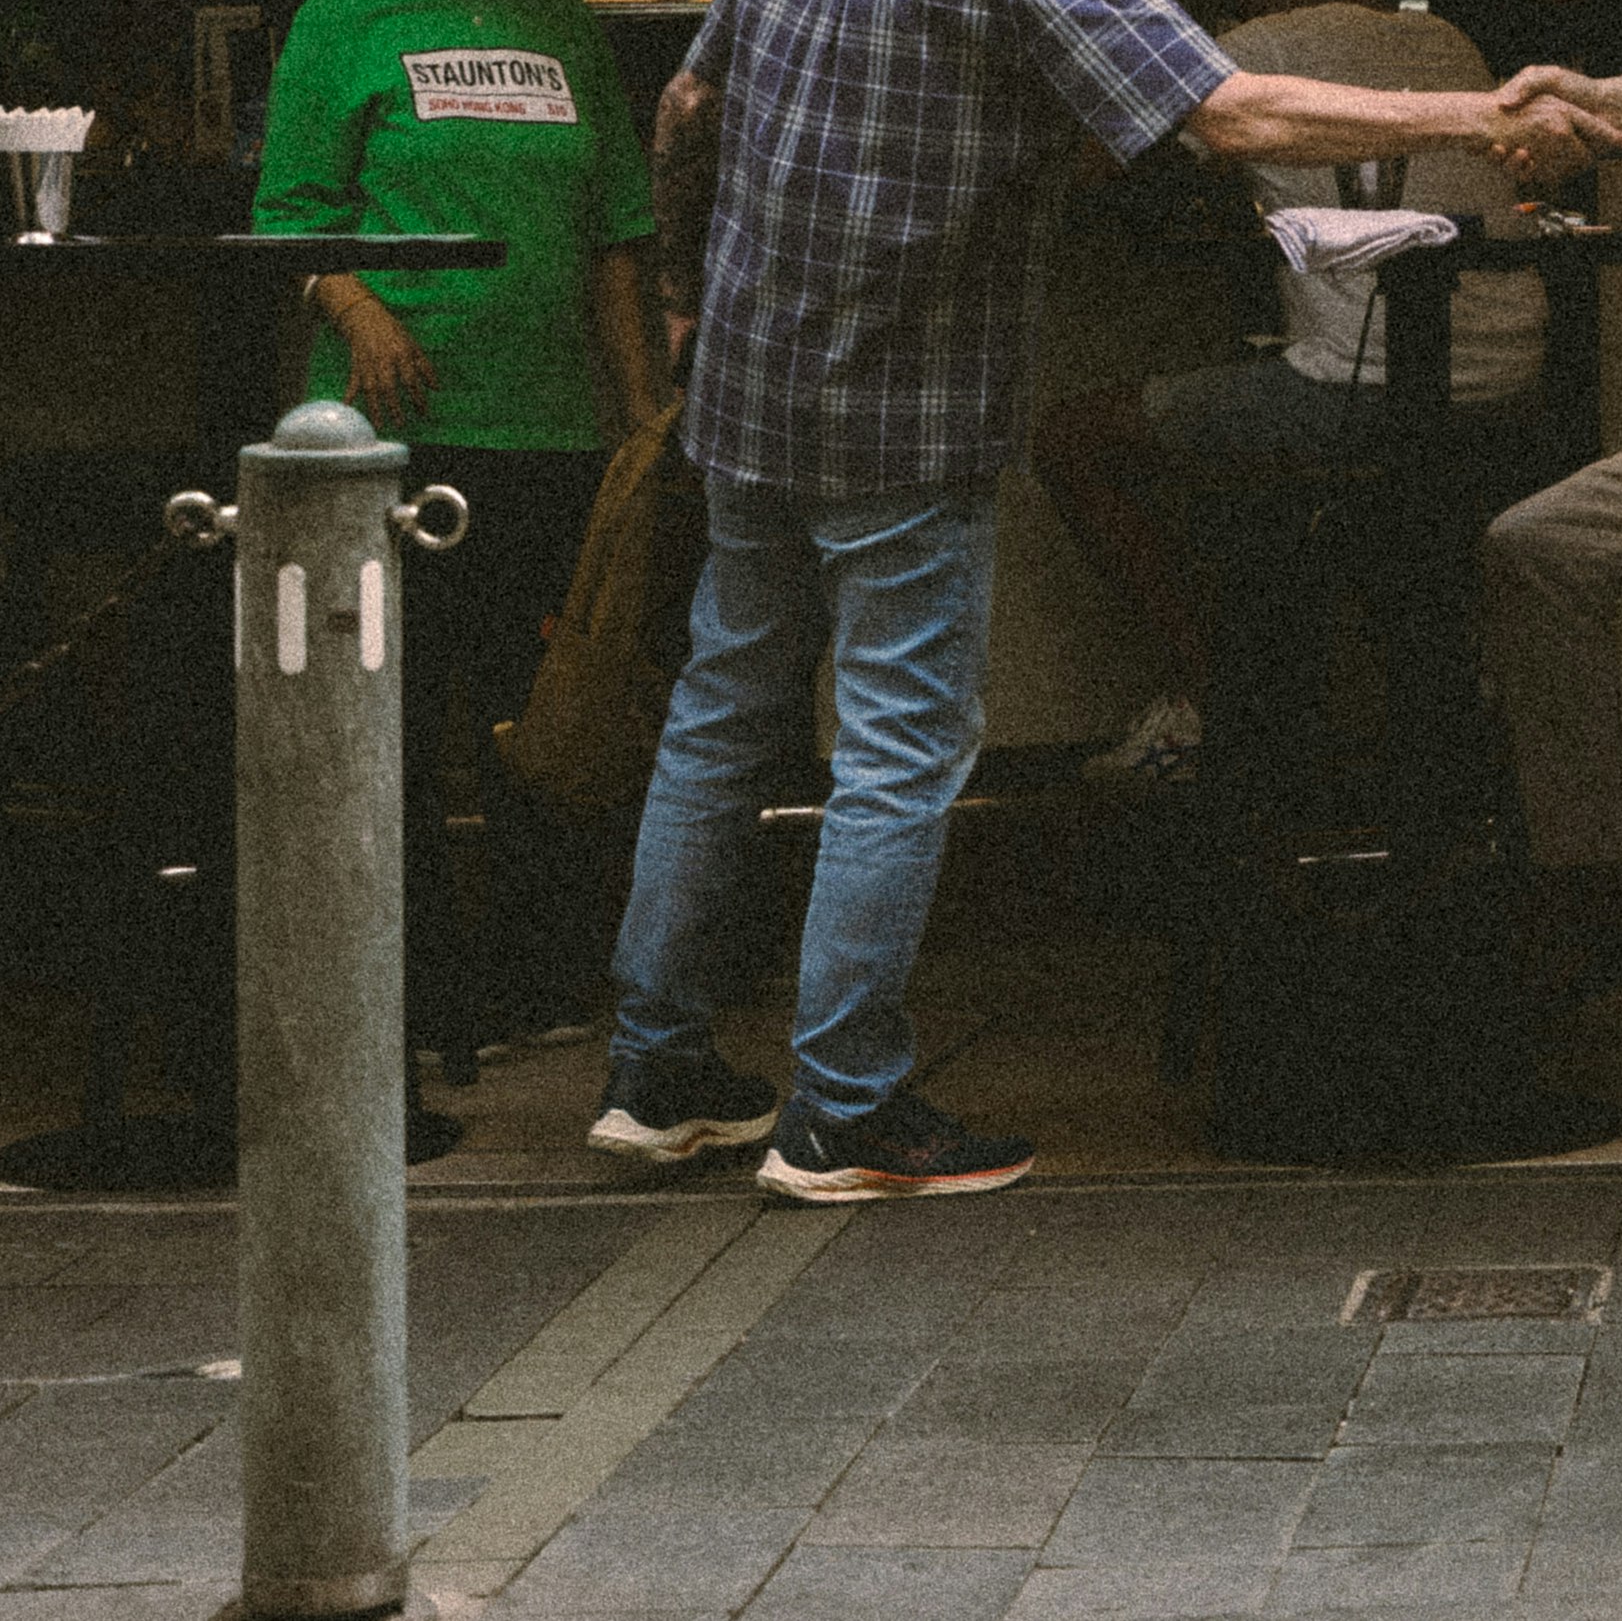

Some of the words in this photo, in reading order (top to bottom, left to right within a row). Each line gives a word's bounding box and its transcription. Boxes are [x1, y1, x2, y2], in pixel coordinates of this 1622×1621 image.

[412, 59, 563, 92] STAUNTON'S
[462, 99, 494, 114] HONG
[494, 100, 527, 115] KONG
